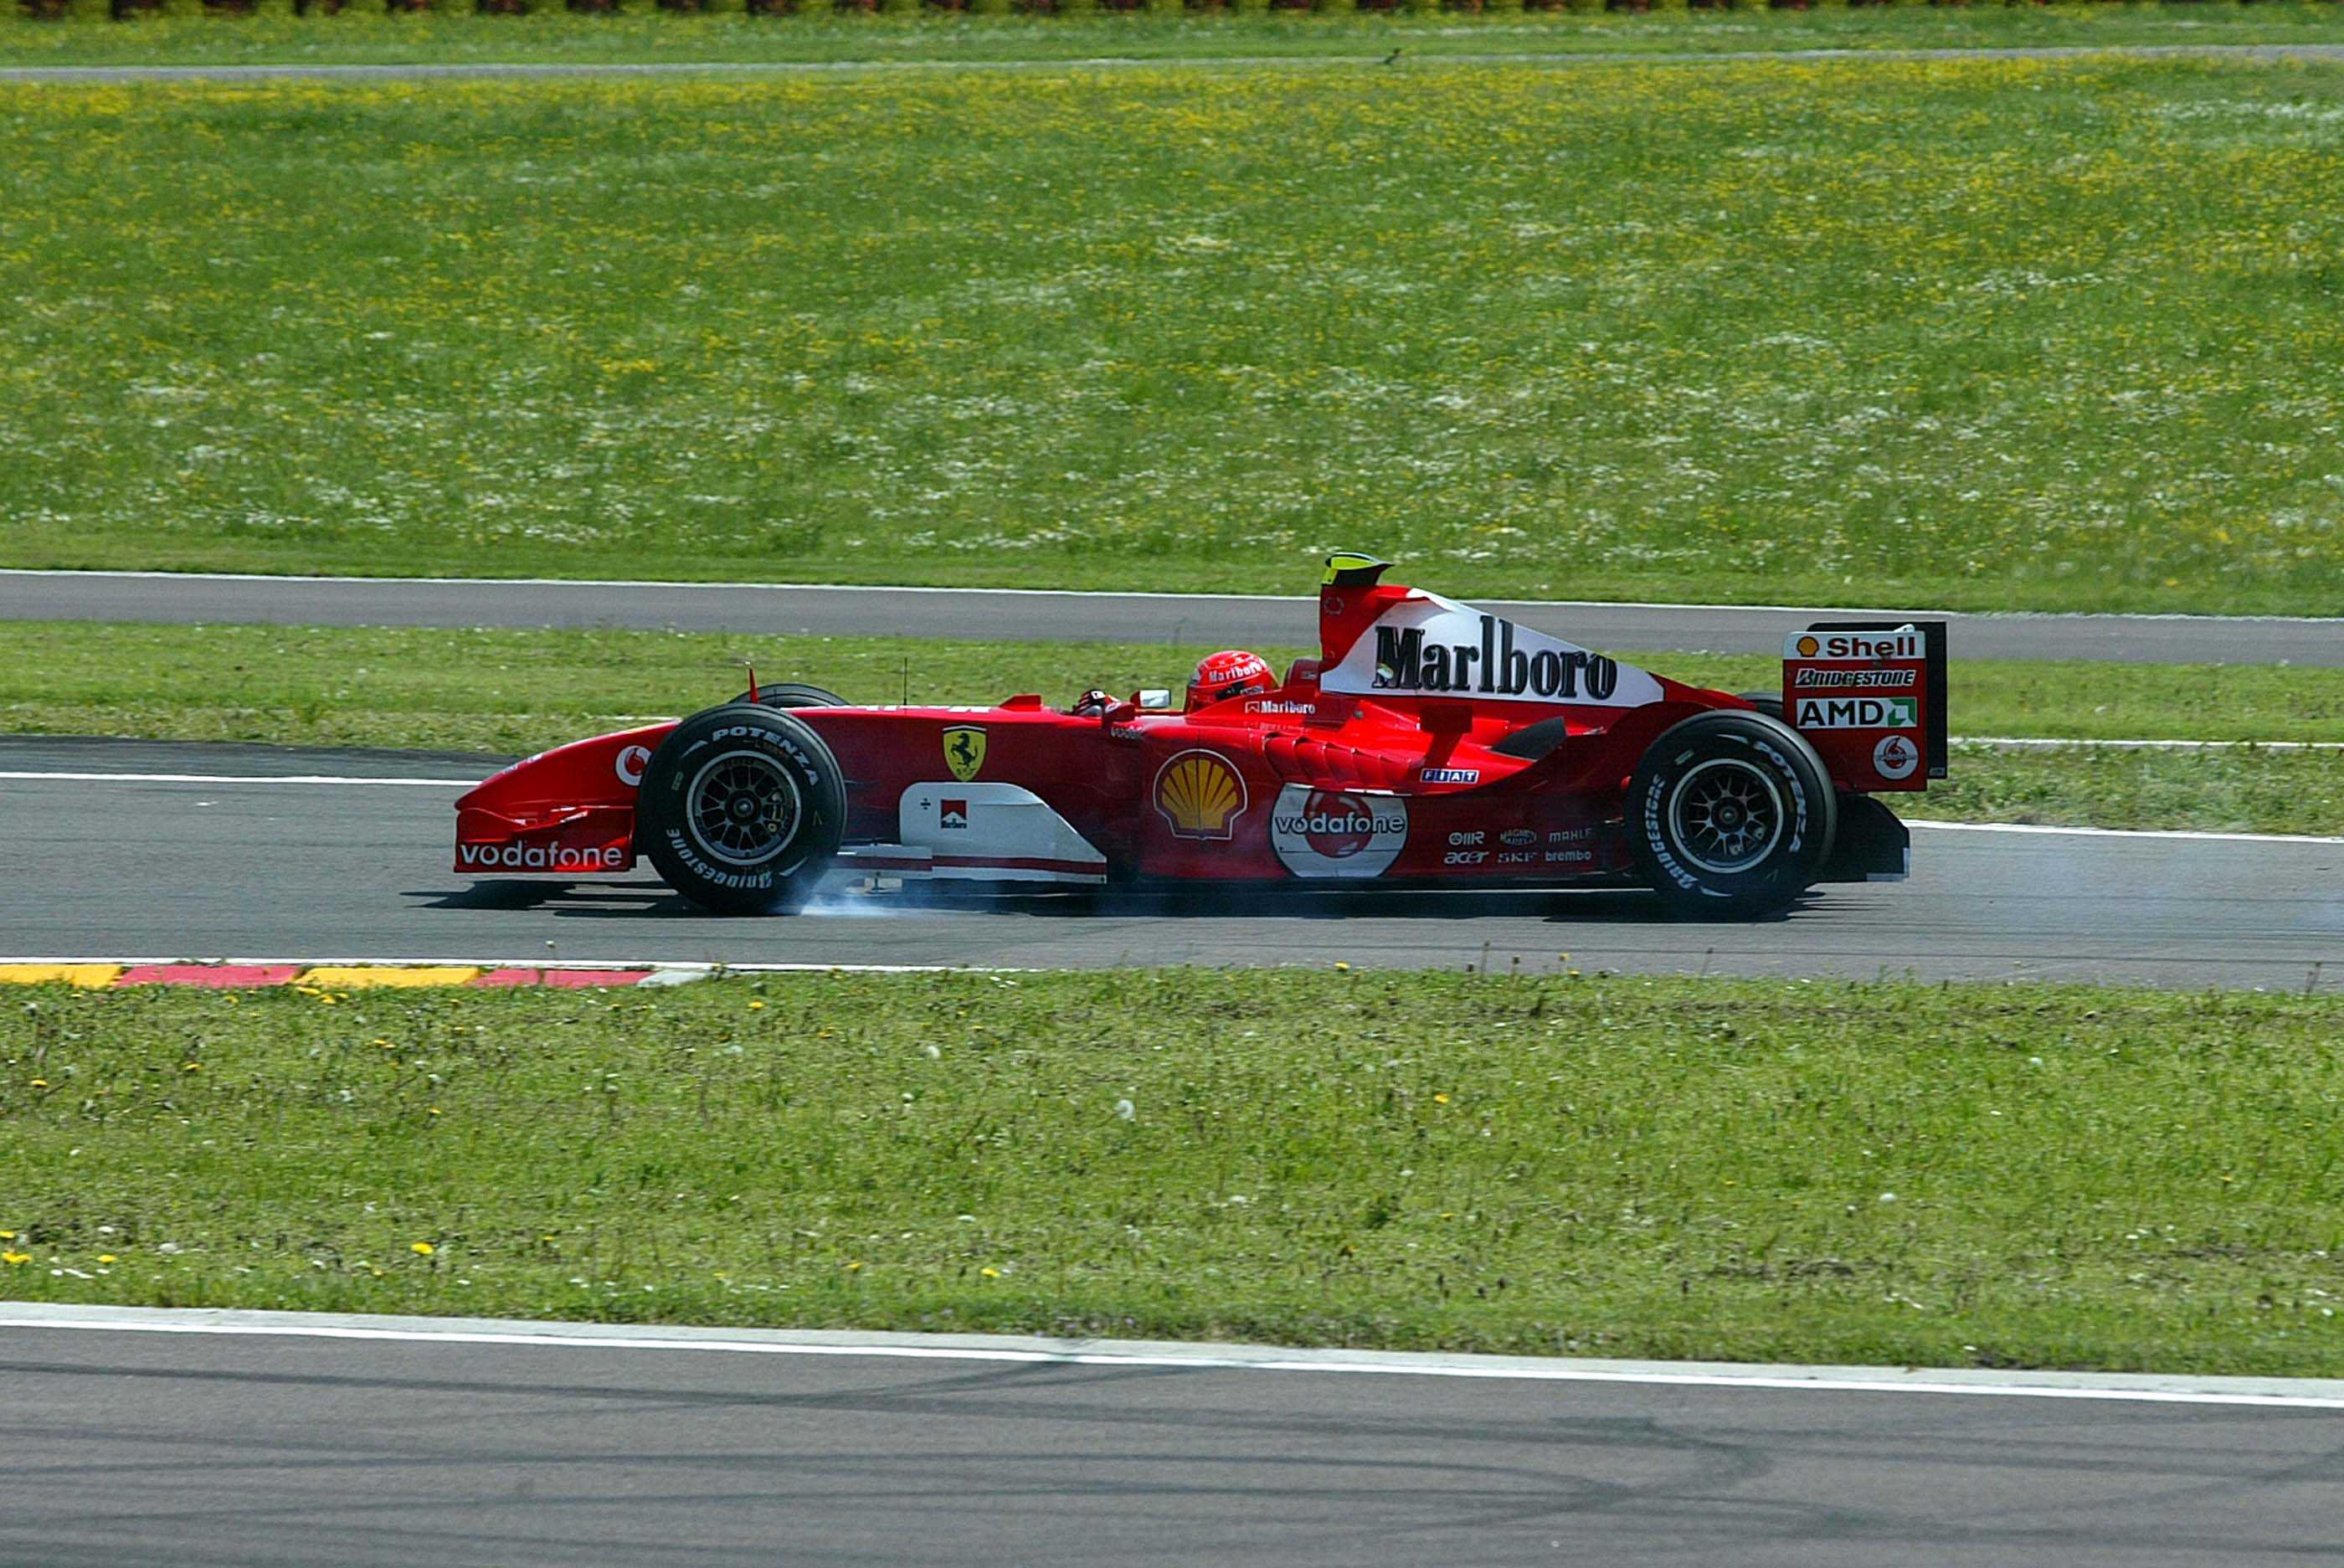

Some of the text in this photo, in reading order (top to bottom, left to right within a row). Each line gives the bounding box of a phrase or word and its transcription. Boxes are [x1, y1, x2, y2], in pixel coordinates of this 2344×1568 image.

[1372, 614, 1617, 700] Marlboro
[1827, 636, 1915, 657] Shell
[1209, 661, 1262, 682] Marlboro
[1261, 701, 1315, 713] Marlboro
[1799, 700, 1884, 726] AMD
[712, 726, 820, 786] POTENZA
[1423, 770, 1477, 782] FIAT
[1276, 811, 1406, 833] vodafone
[460, 840, 623, 866] vodafone
[1444, 851, 1489, 864] acer
[1545, 850, 1591, 862] brembo
